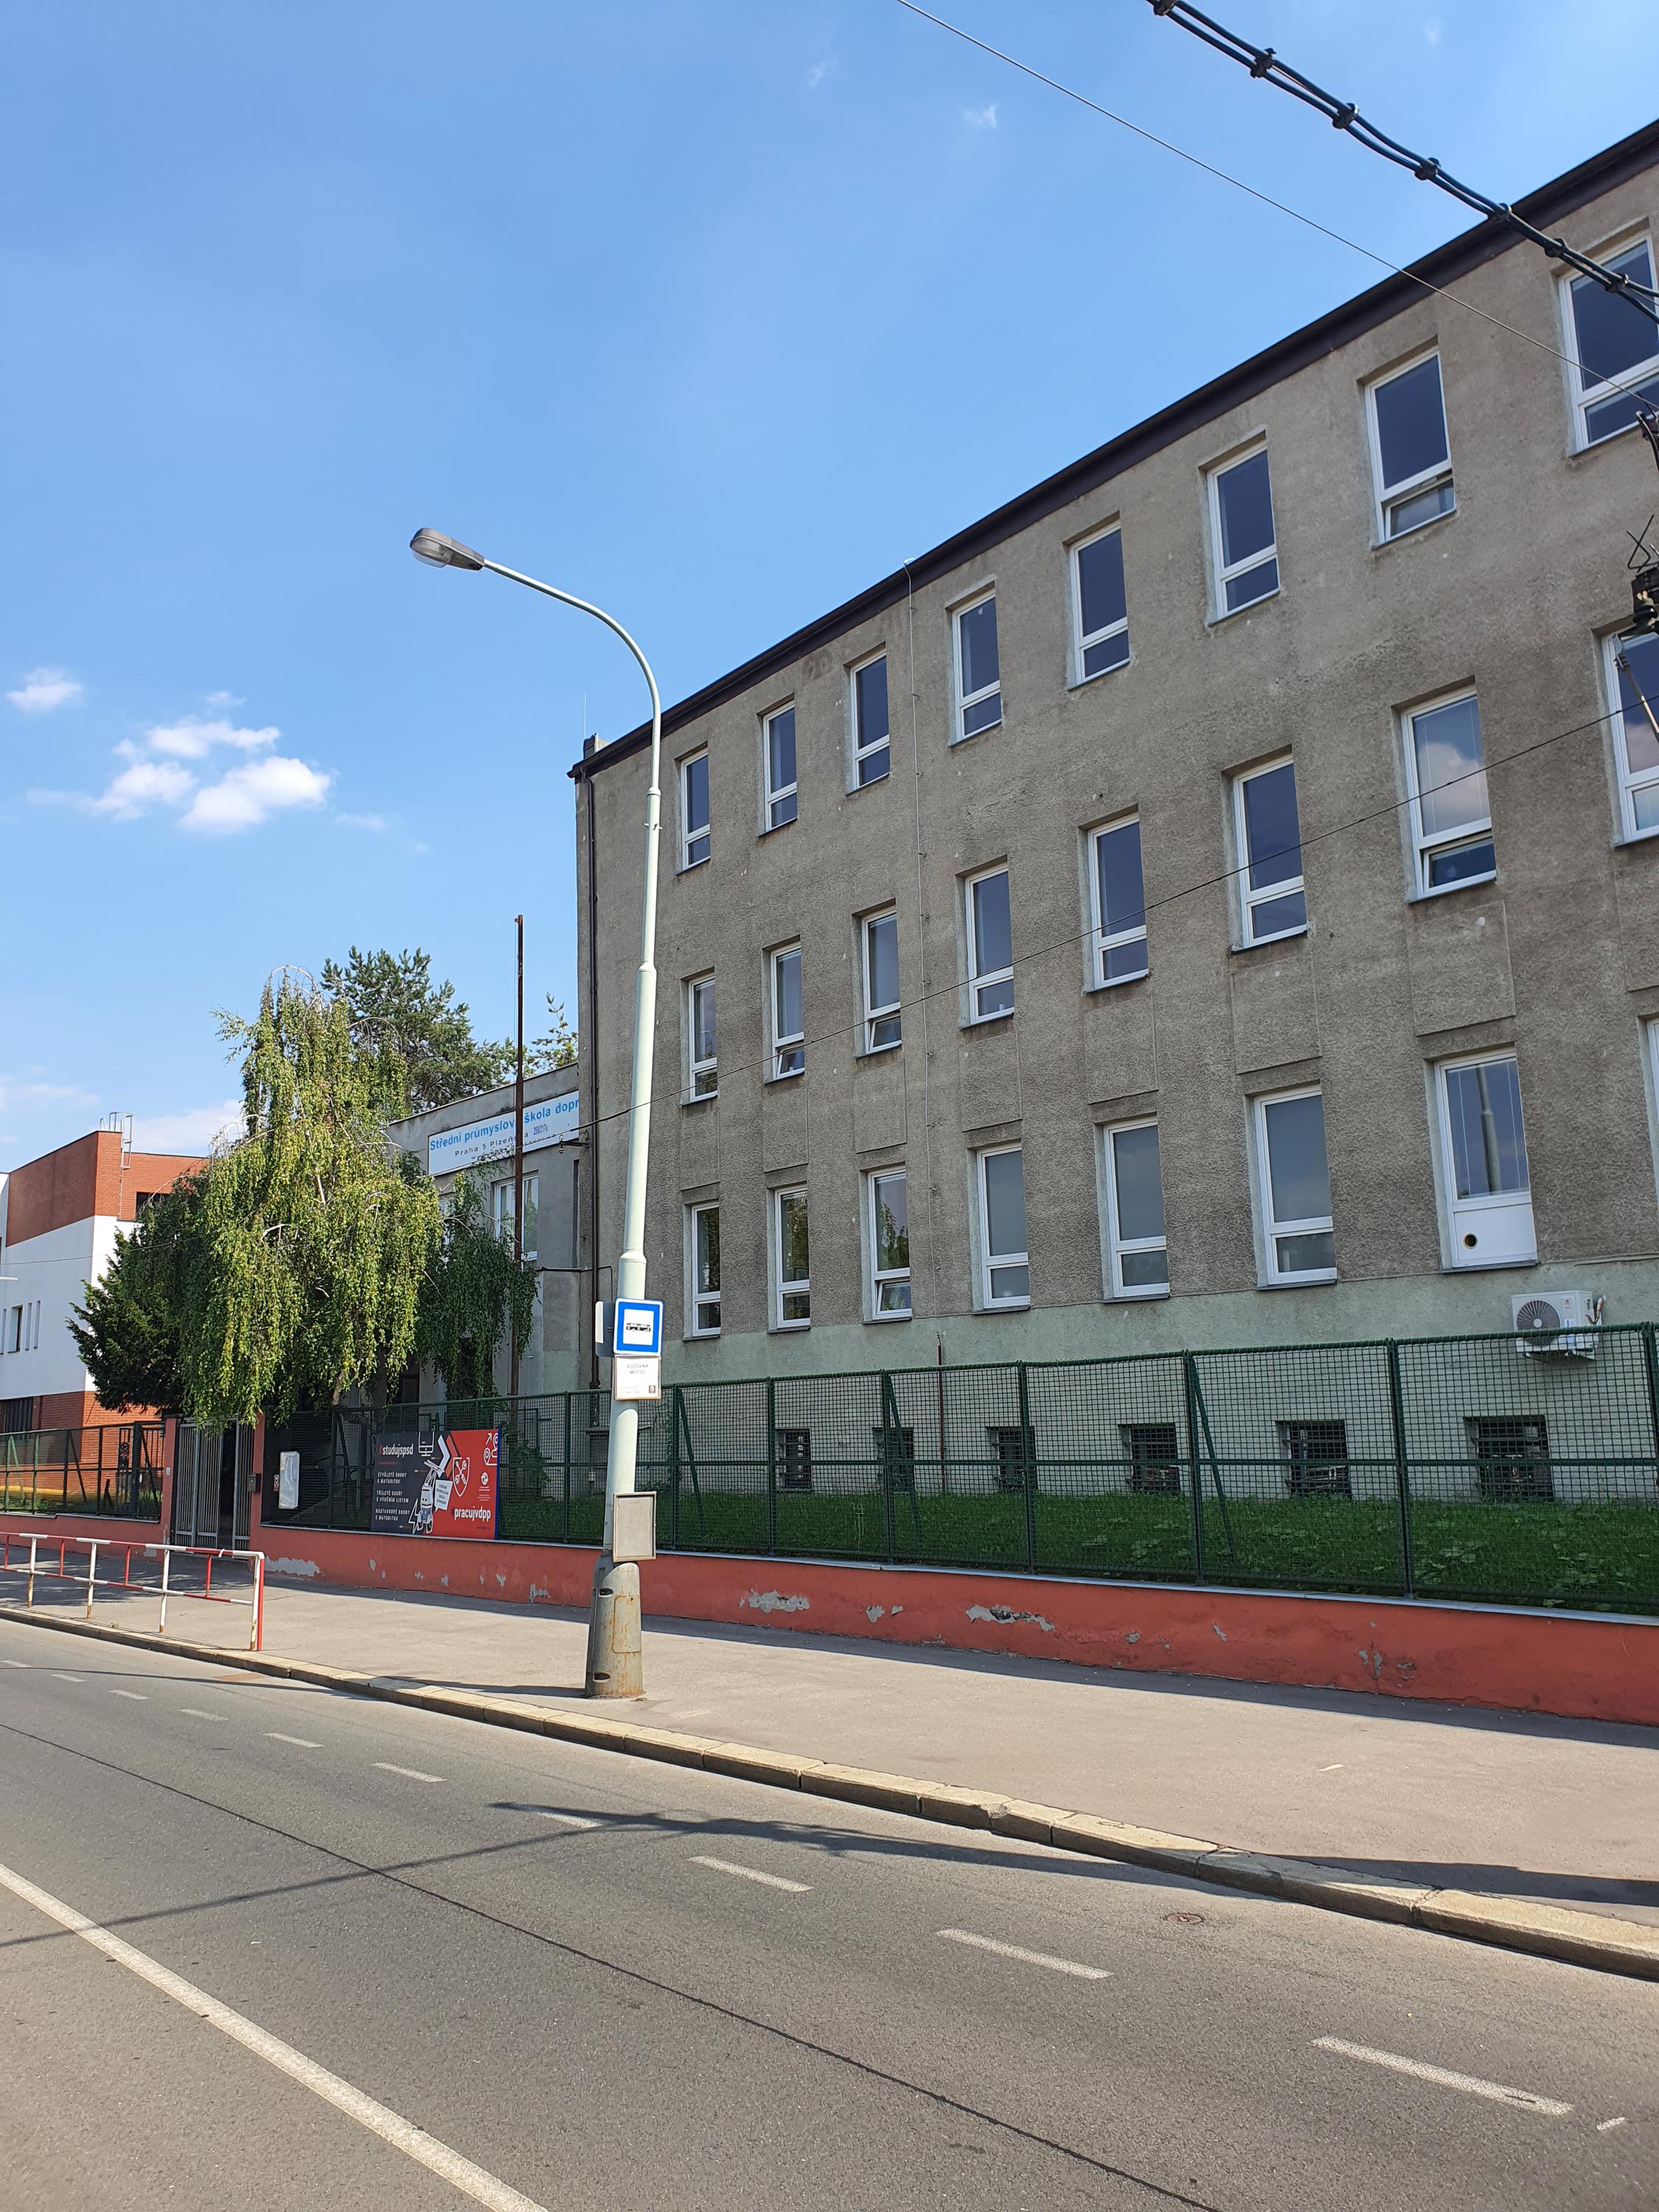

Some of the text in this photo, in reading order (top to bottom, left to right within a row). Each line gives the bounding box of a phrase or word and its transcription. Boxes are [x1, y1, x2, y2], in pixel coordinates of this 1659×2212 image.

[430, 1131, 462, 1150] Střední
[465, 1119, 515, 1144] průmyslov
[524, 1107, 551, 1124] škola
[455, 1147, 479, 1157] Praha
